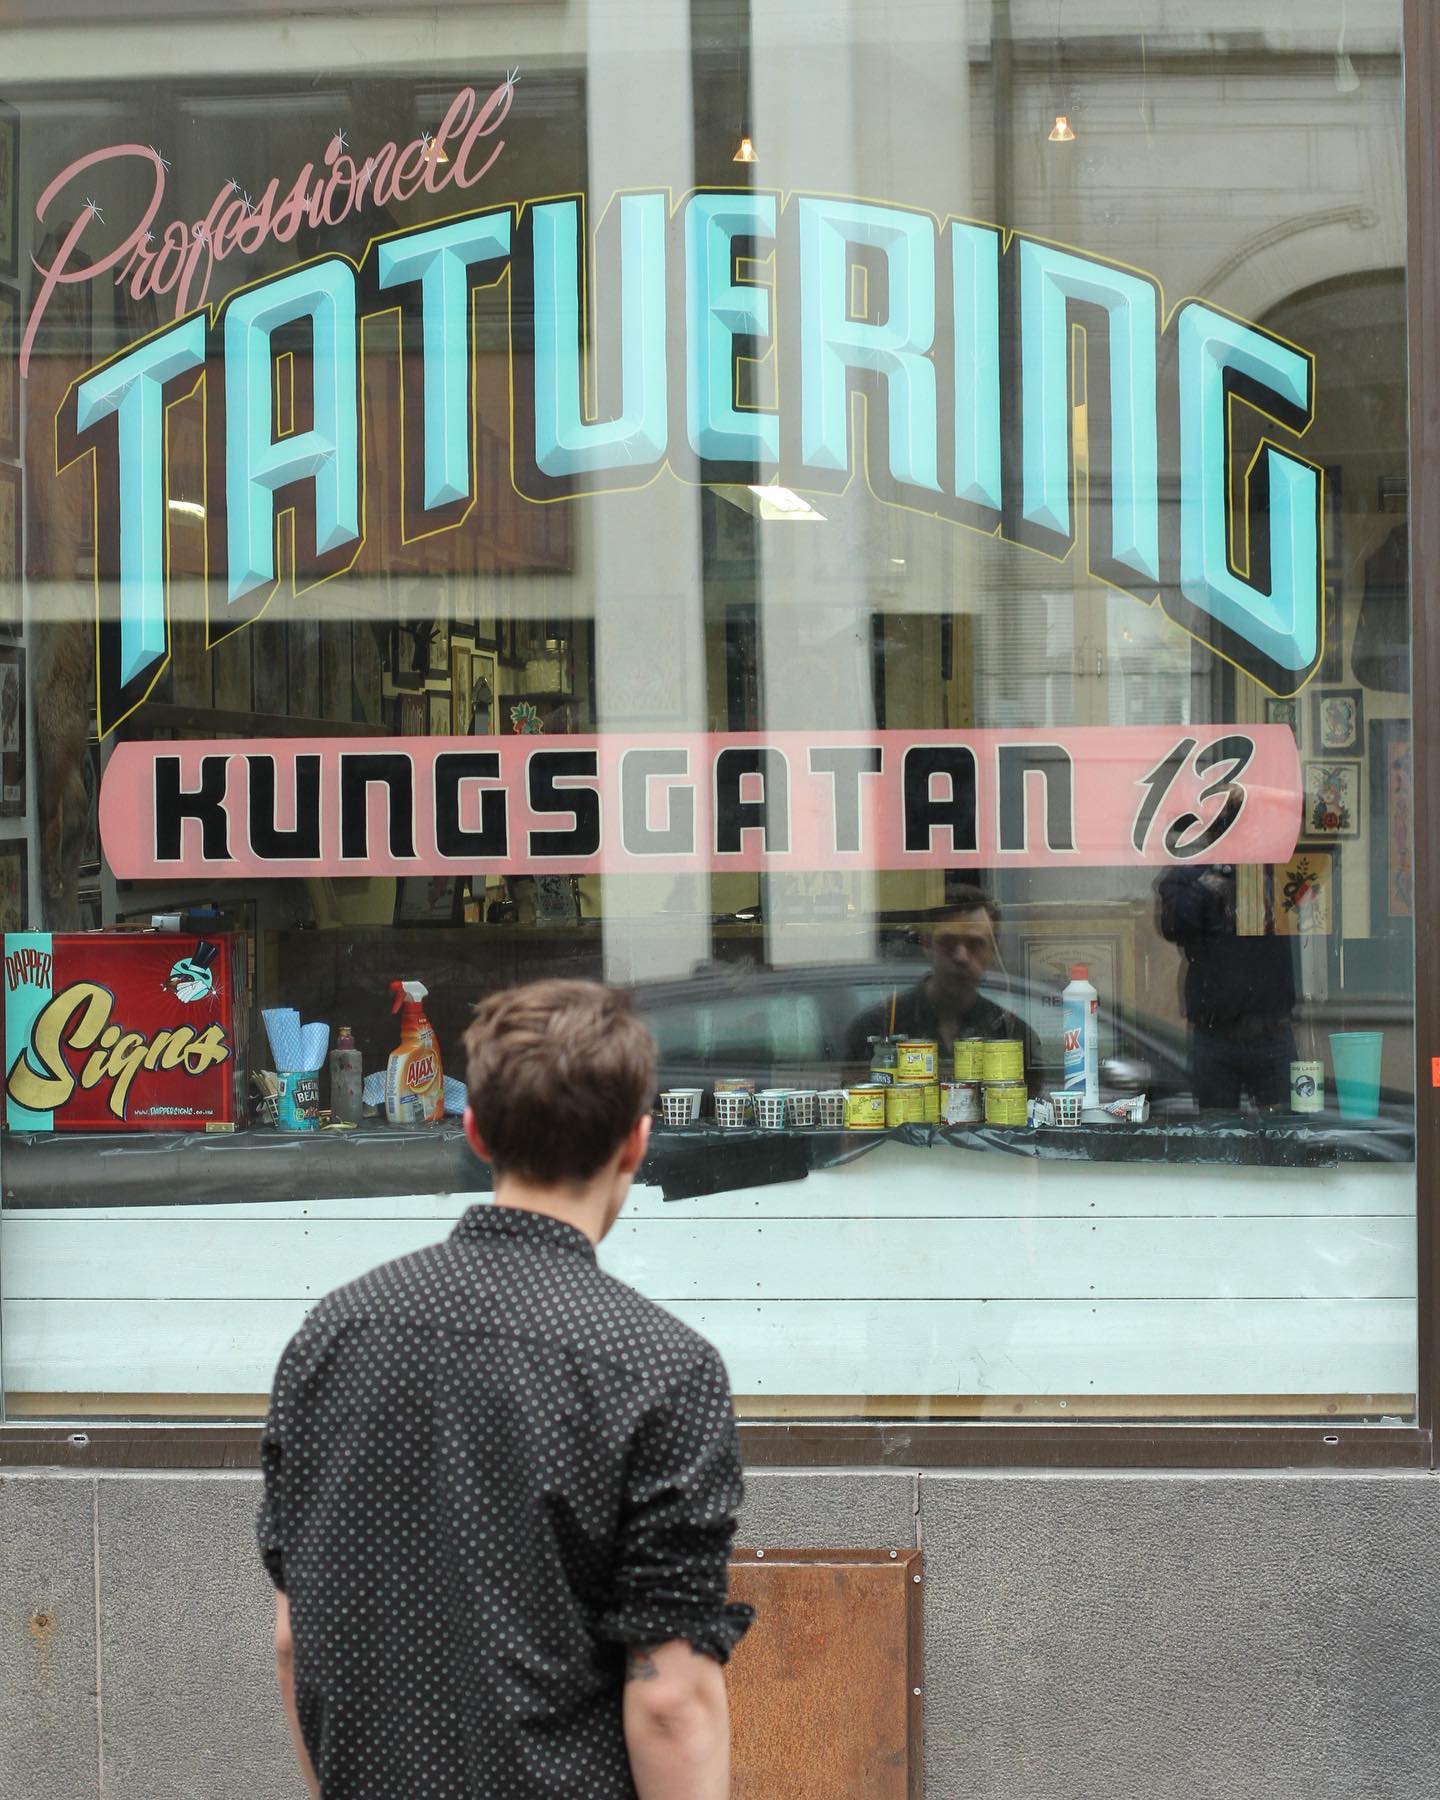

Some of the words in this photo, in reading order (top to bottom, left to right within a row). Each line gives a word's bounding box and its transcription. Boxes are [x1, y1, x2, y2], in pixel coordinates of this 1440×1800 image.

[20, 80, 514, 378] Professionell
[75, 191, 1318, 689] TATUERING
[152, 744, 1078, 862] KUNGSGATAN
[1131, 734, 1256, 860] 13
[4, 947, 53, 992] DAPPER
[7, 979, 232, 1121] Signs
[407, 1055, 434, 1088] AJAX
